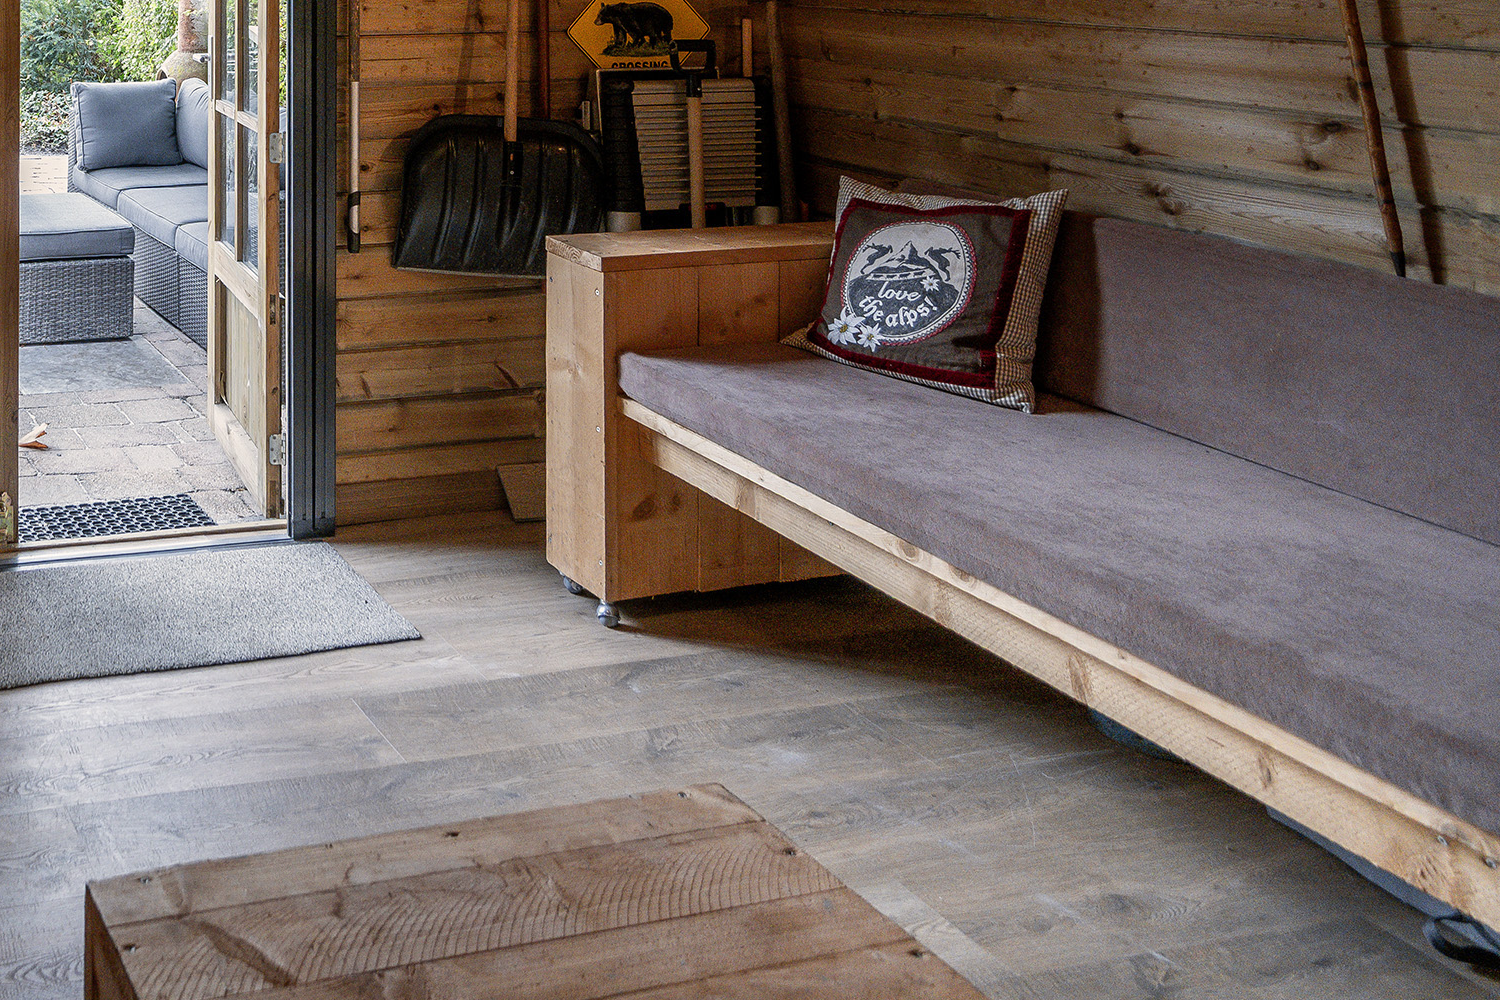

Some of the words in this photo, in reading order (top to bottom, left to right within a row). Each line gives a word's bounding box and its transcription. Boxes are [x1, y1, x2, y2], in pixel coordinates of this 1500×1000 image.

[878, 281, 921, 301] love
[859, 296, 884, 321] the
[885, 296, 938, 327] alps!
